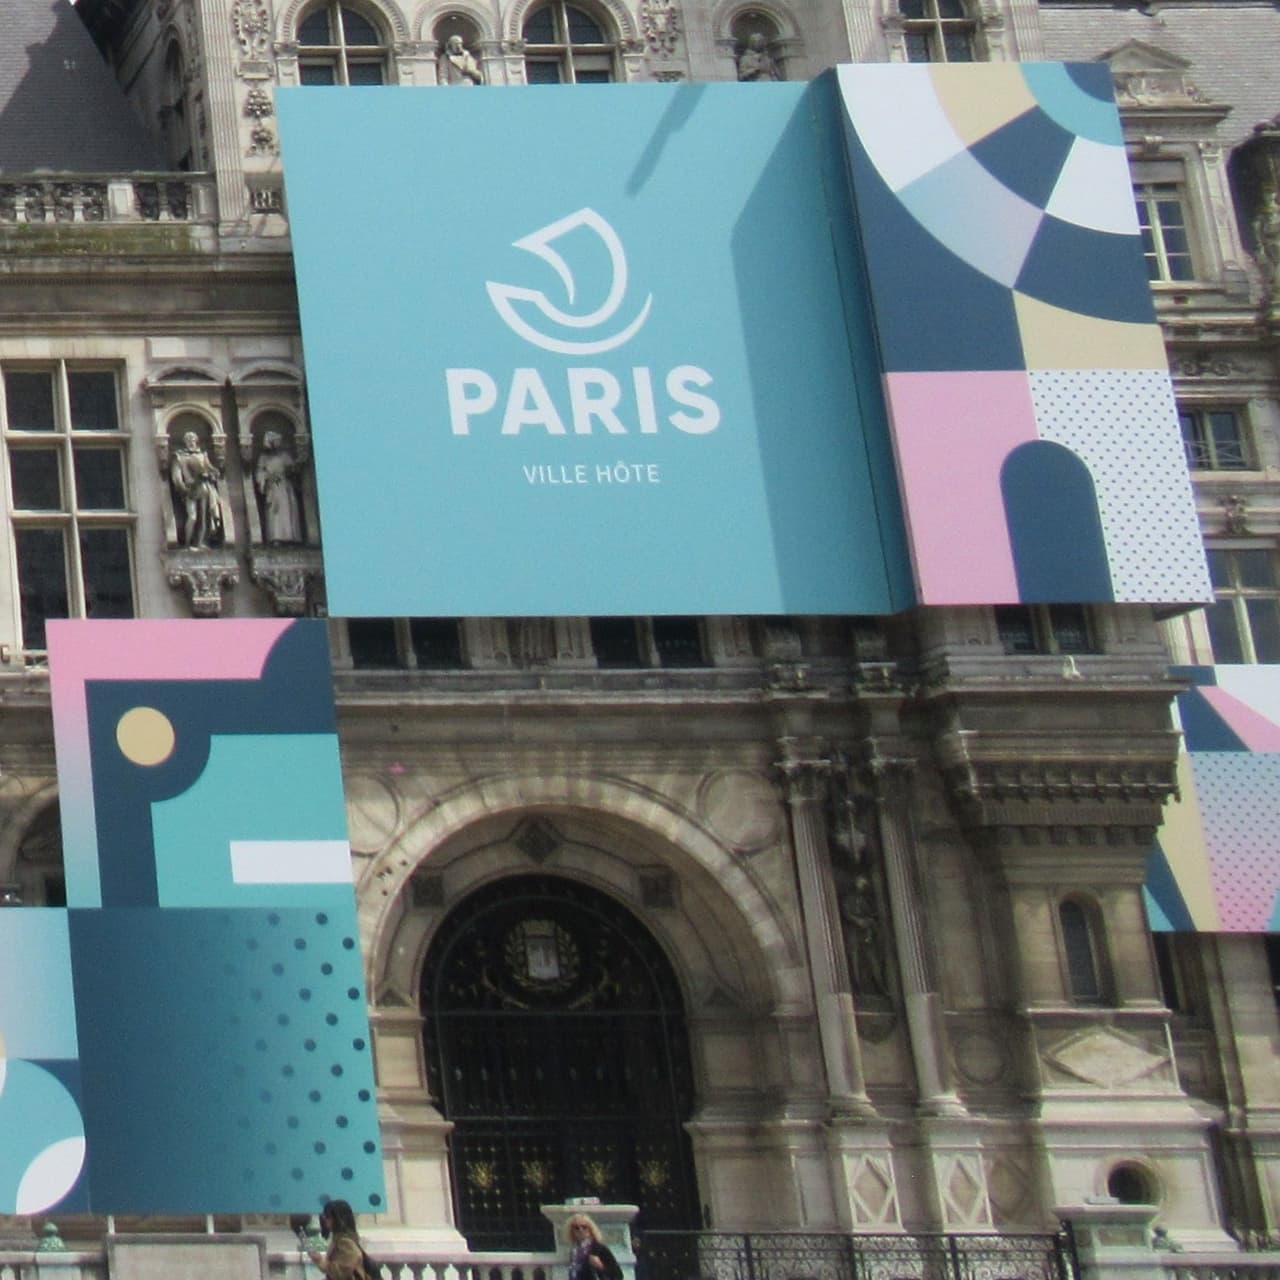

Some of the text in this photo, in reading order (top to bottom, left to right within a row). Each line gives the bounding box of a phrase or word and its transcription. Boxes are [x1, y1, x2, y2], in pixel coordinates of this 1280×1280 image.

[445, 365, 721, 435] PARIS
[522, 460, 660, 484] VILLE HÔTE
